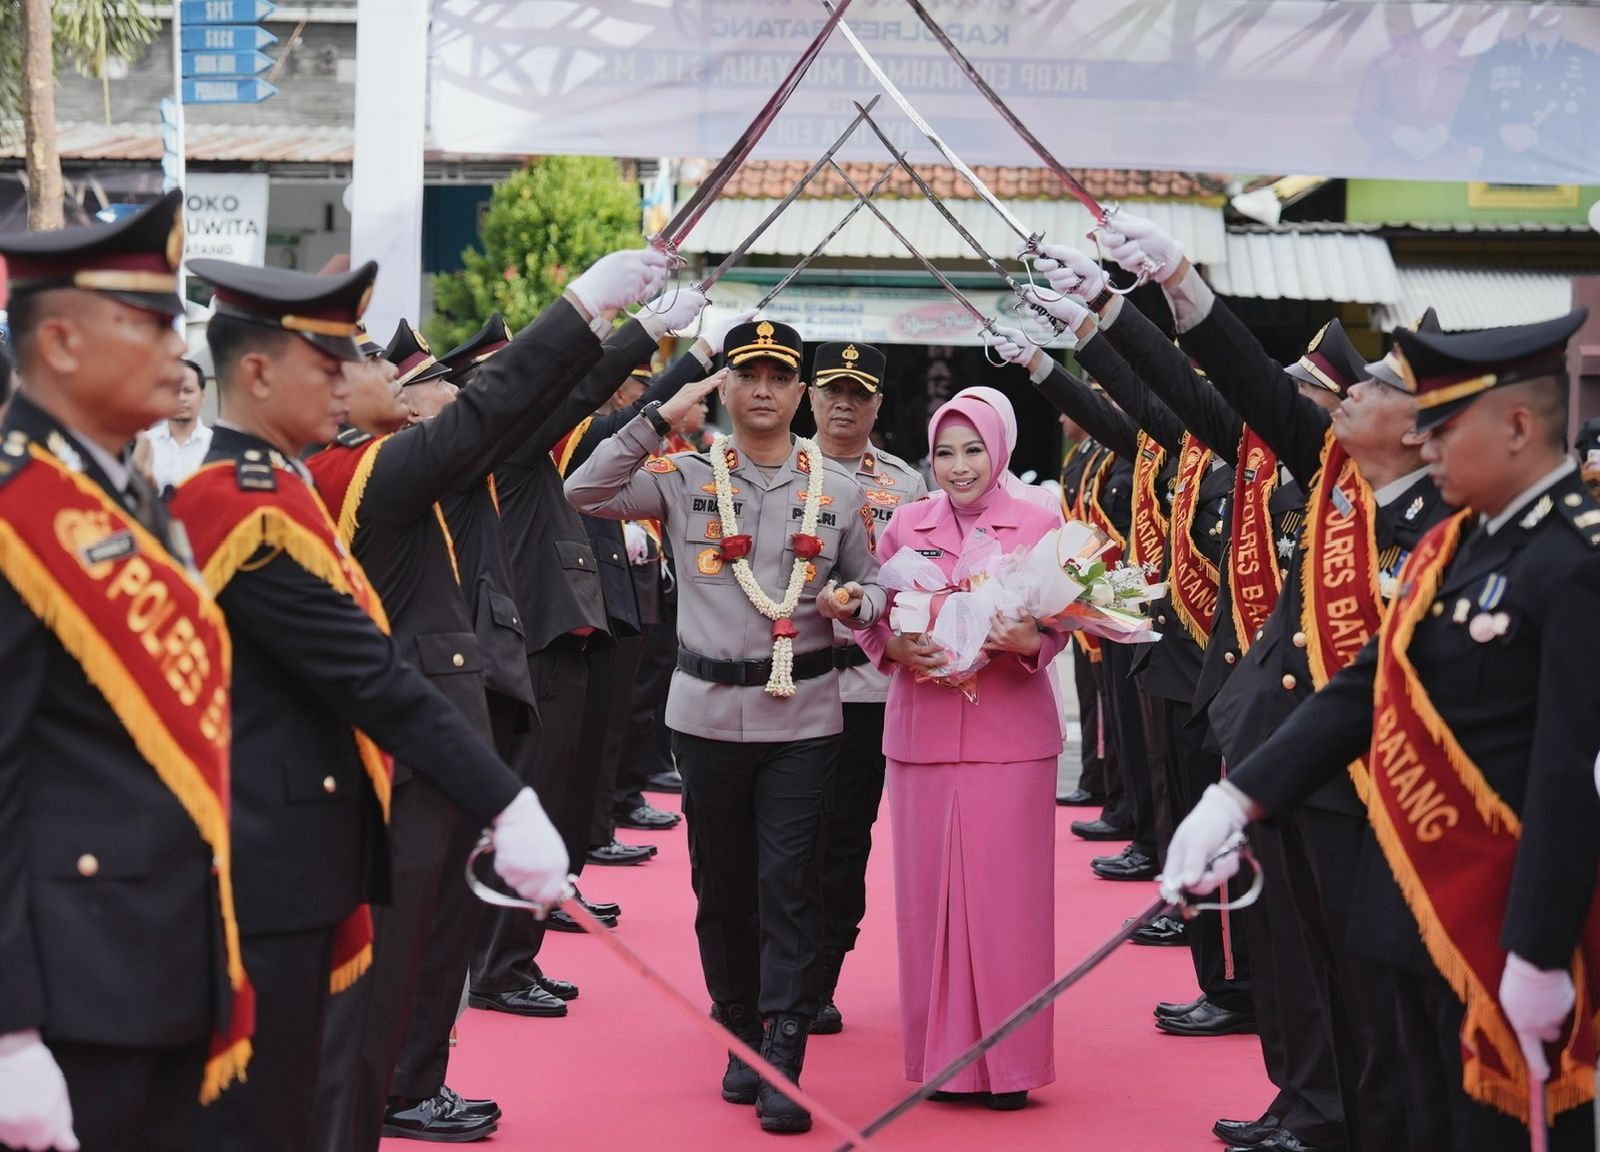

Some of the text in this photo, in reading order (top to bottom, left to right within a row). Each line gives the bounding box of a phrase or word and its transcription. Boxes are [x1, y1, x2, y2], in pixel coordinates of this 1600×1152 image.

[187, 195, 239, 213] OKO
[186, 219, 259, 235] UWITA
[186, 244, 233, 255] ATANG
[693, 498, 743, 516] EDI RAAT
[1136, 508, 1163, 574] BATAN
[1237, 488, 1261, 576] POLRES
[105, 556, 211, 707] POLRES
[1376, 702, 1460, 842] BATANG
